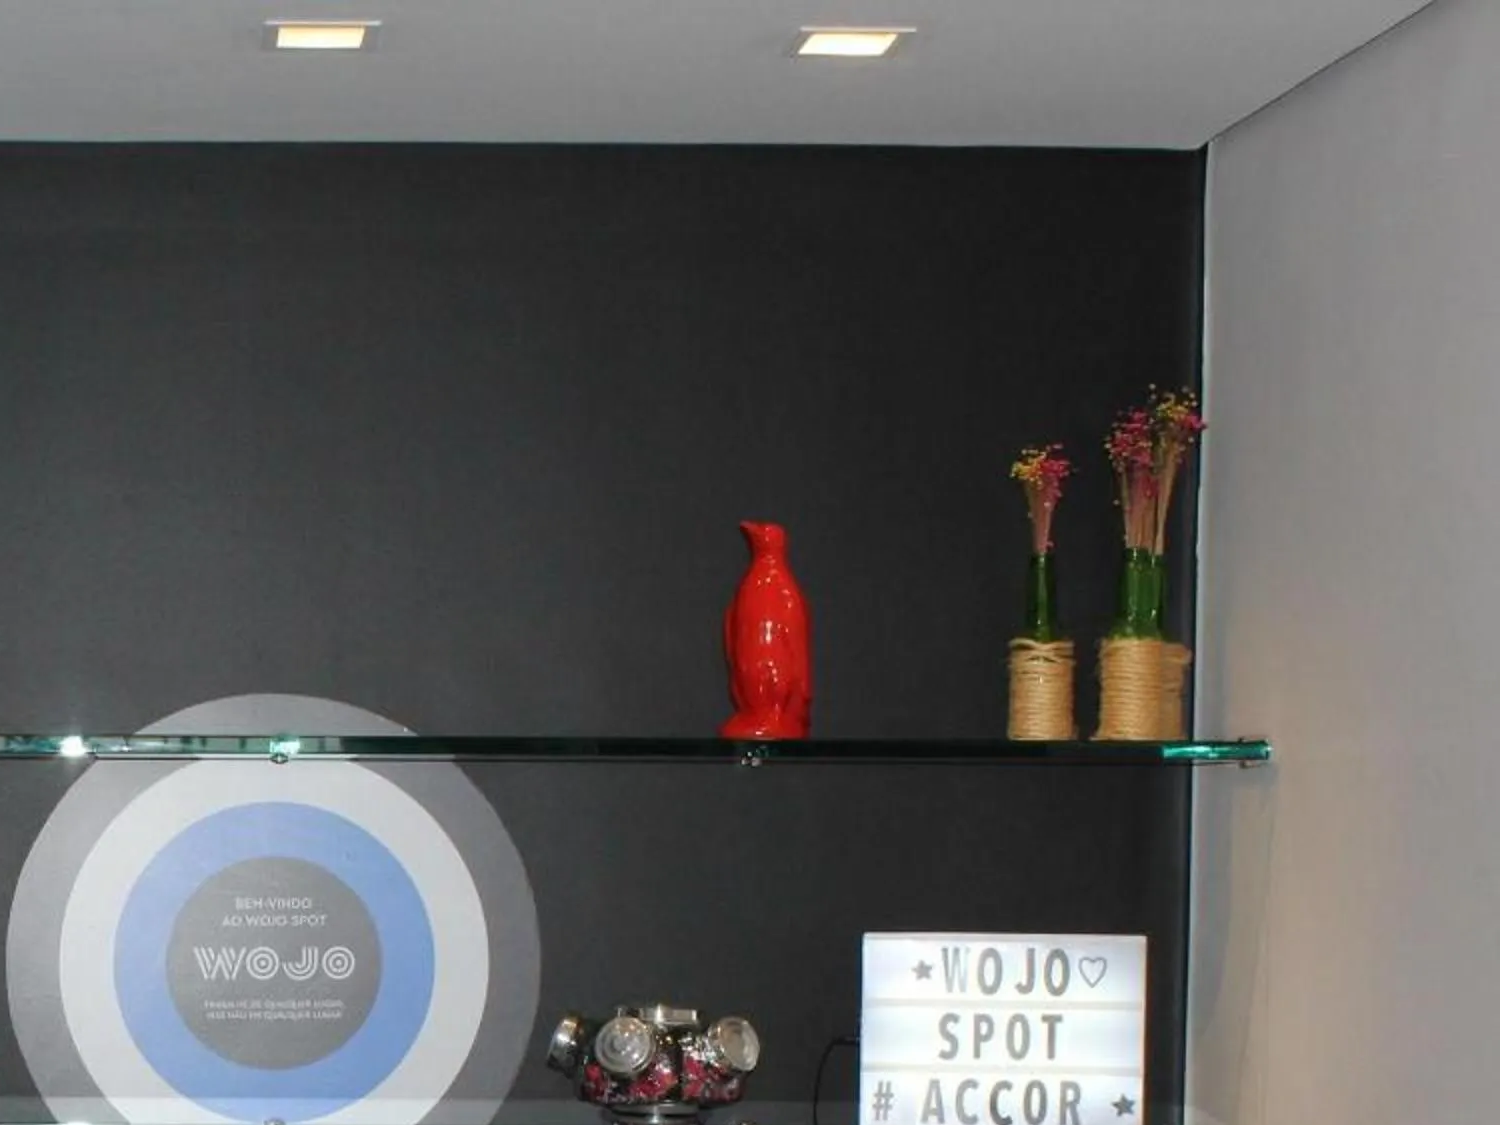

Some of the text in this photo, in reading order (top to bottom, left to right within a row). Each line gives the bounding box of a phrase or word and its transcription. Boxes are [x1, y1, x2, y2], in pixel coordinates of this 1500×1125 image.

[222, 914, 243, 926] AO
[291, 914, 328, 926] SPOT
[193, 945, 356, 980] WOJO
[941, 947, 1071, 997] WOJO
[937, 1012, 1063, 1060] SPOT
